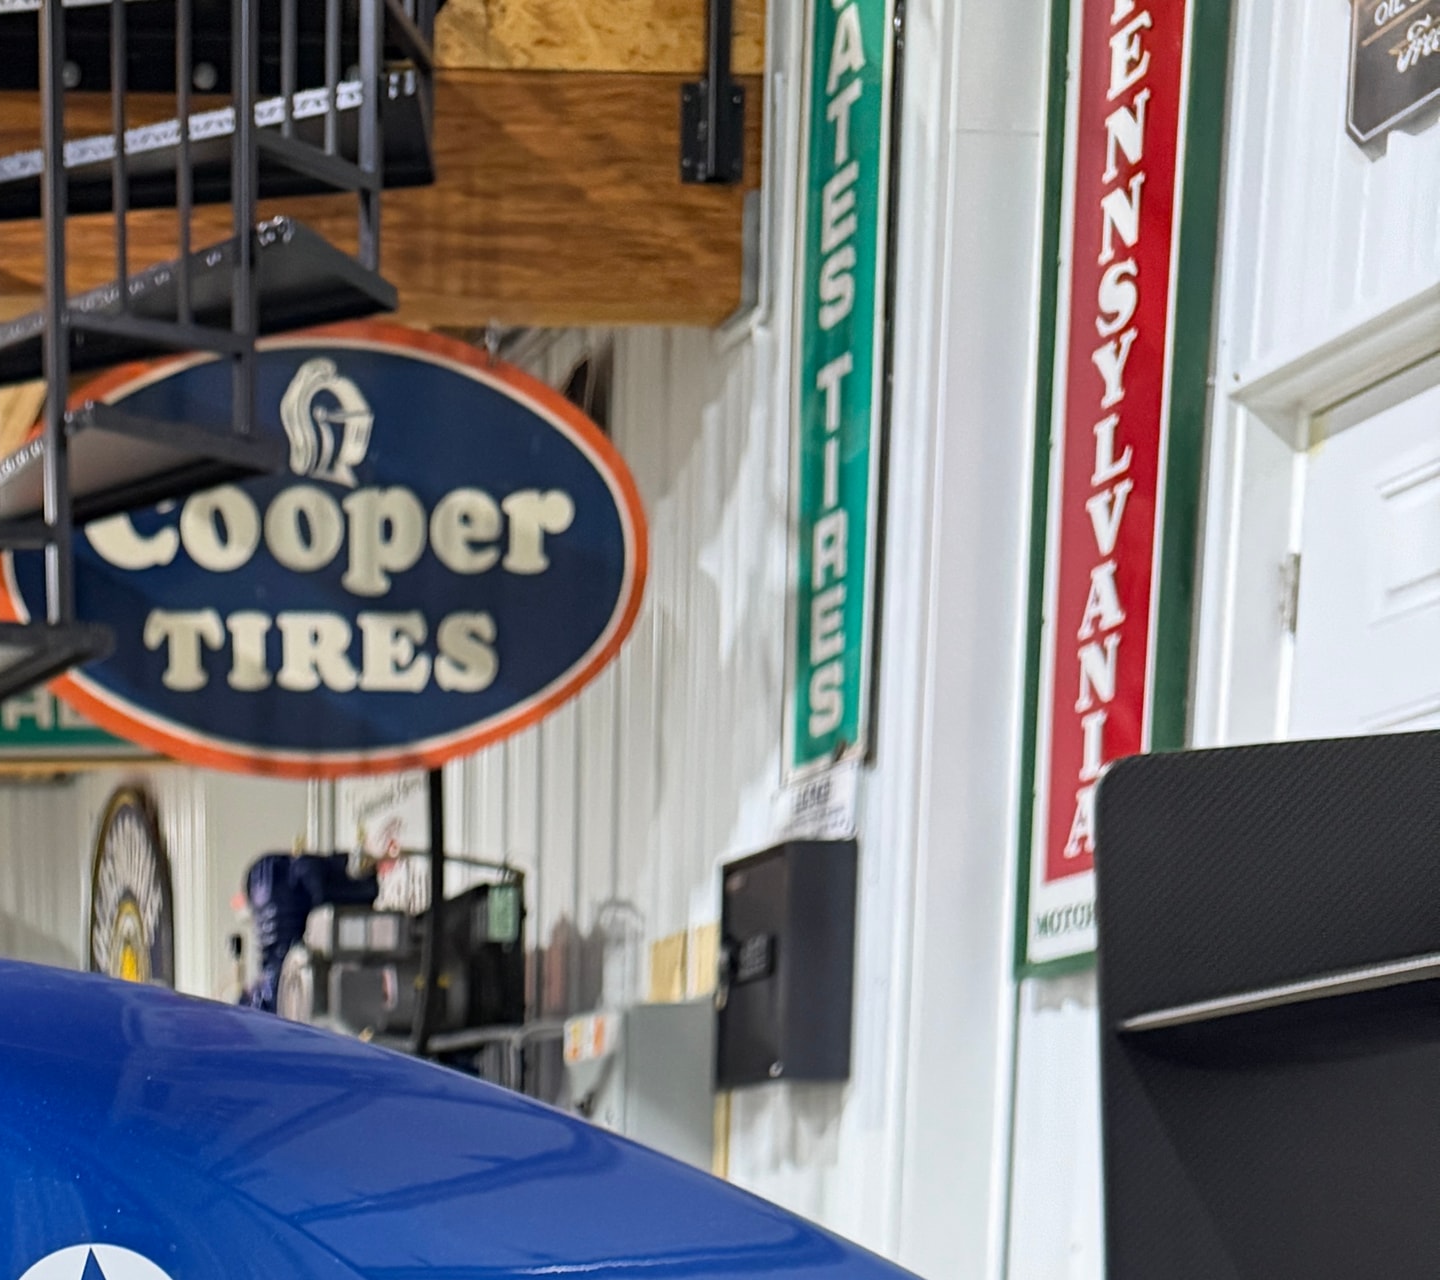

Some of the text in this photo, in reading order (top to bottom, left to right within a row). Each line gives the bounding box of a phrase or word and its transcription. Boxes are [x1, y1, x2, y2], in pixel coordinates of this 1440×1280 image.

[819, 0, 865, 330] ATES
[1063, 0, 1152, 859] ENNSYLVANIA
[143, 607, 499, 693] TIRES
